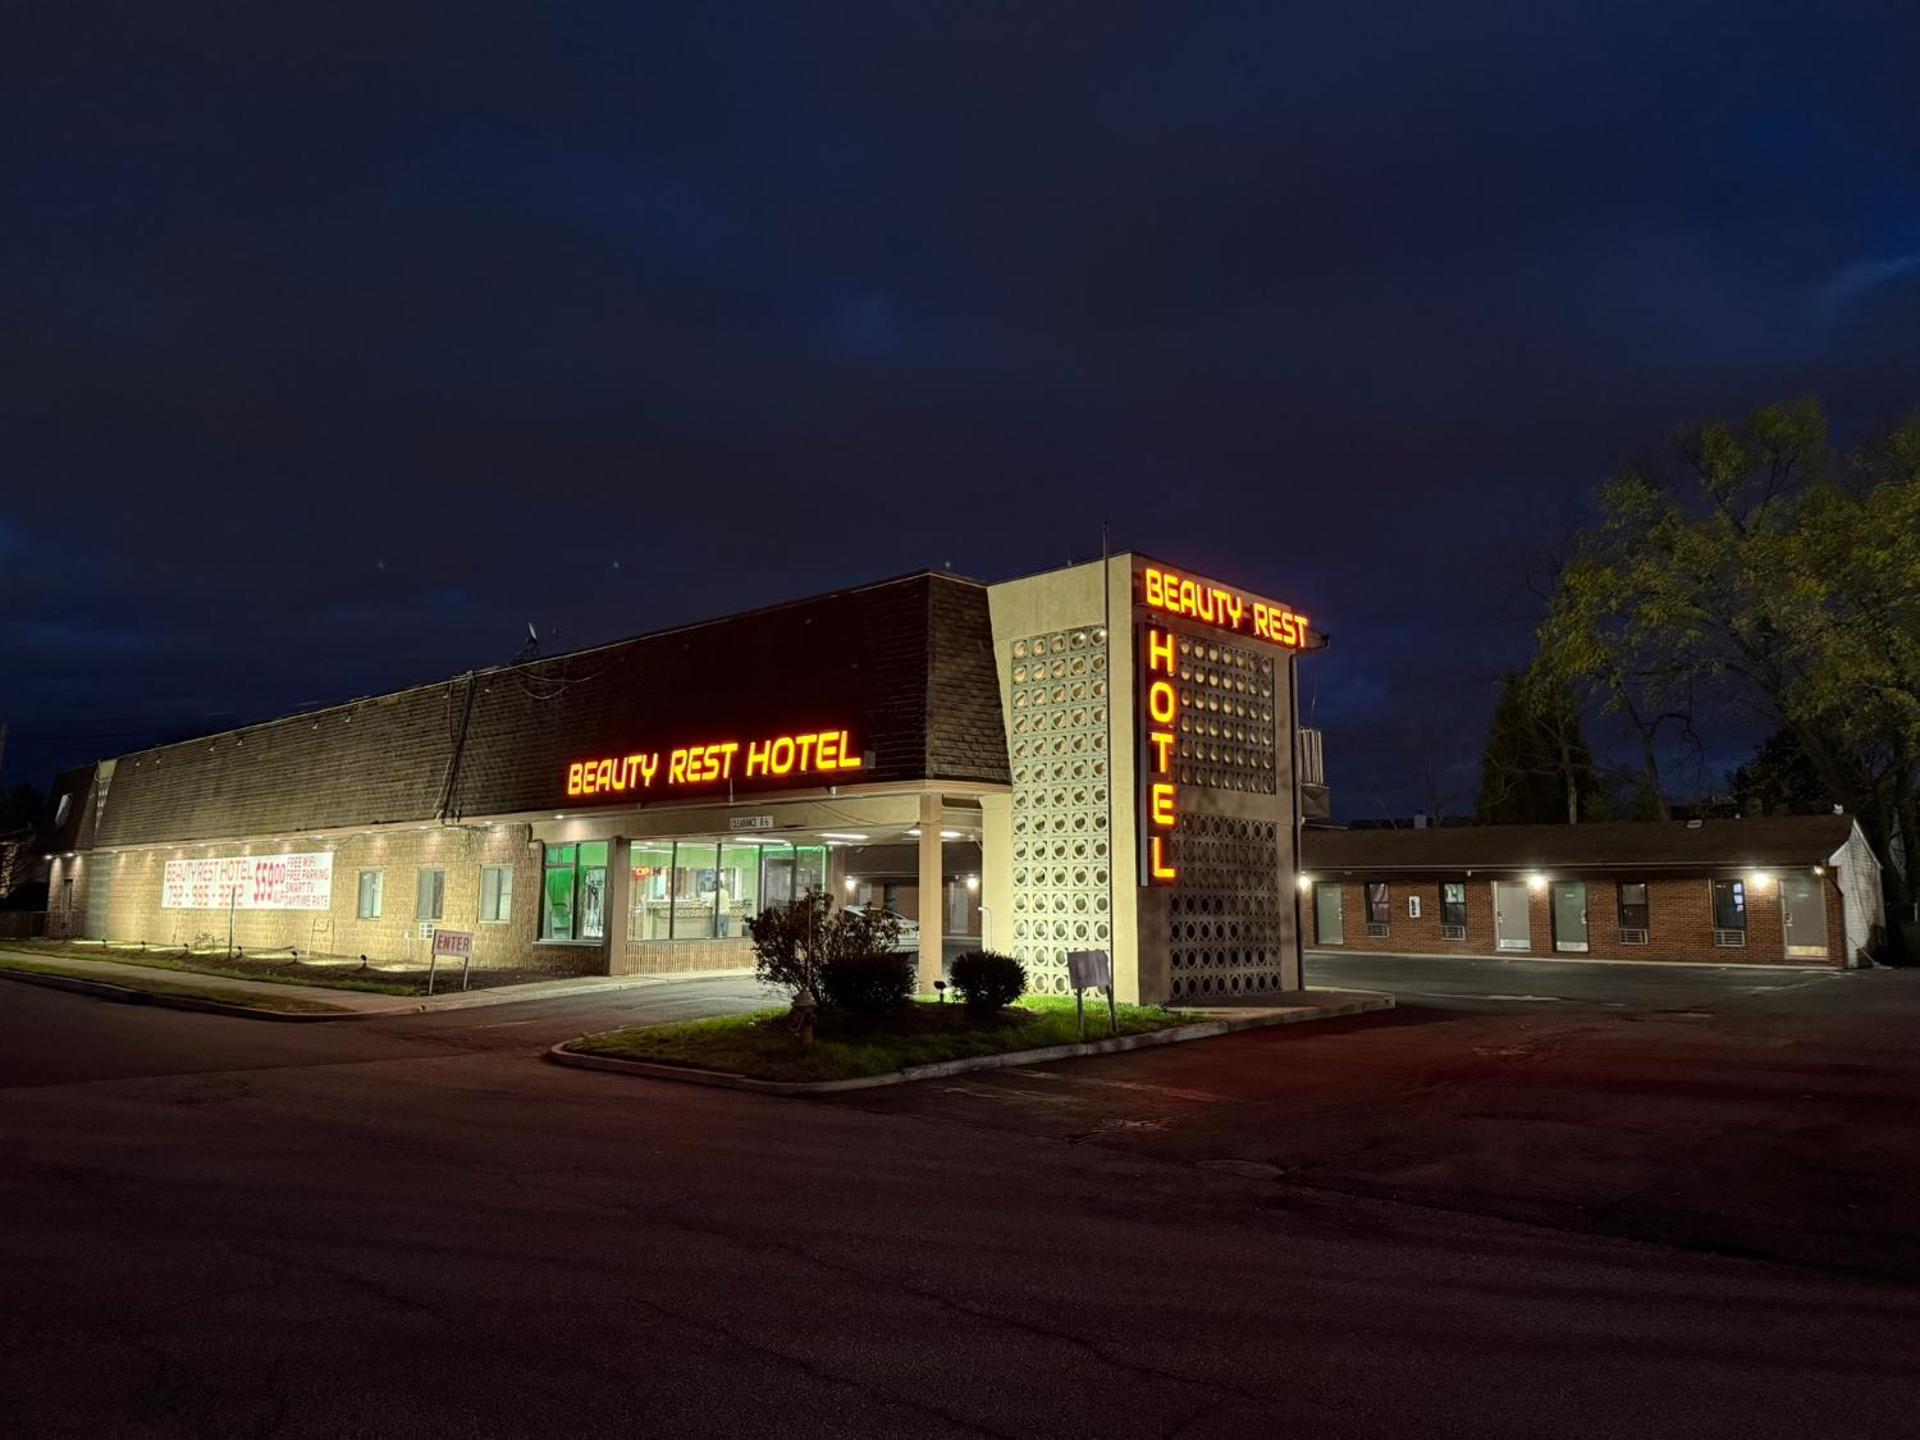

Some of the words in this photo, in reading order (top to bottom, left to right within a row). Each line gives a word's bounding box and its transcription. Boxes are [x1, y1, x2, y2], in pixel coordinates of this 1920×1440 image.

[1145, 568, 1242, 629] BEAUTY
[1252, 602, 1309, 648] REST
[568, 752, 658, 796] BEAUTY
[668, 743, 738, 785] REST
[746, 730, 862, 777] HOTEL
[1149, 629, 1176, 880] HOTEL
[167, 862, 197, 882] BEAUTY
[199, 861, 220, 881] REST
[220, 859, 253, 881] HOTEL
[287, 855, 302, 868] FREE
[286, 868, 302, 881] FREE
[302, 867, 329, 881] PARKING
[436, 934, 470, 951] ENTER
